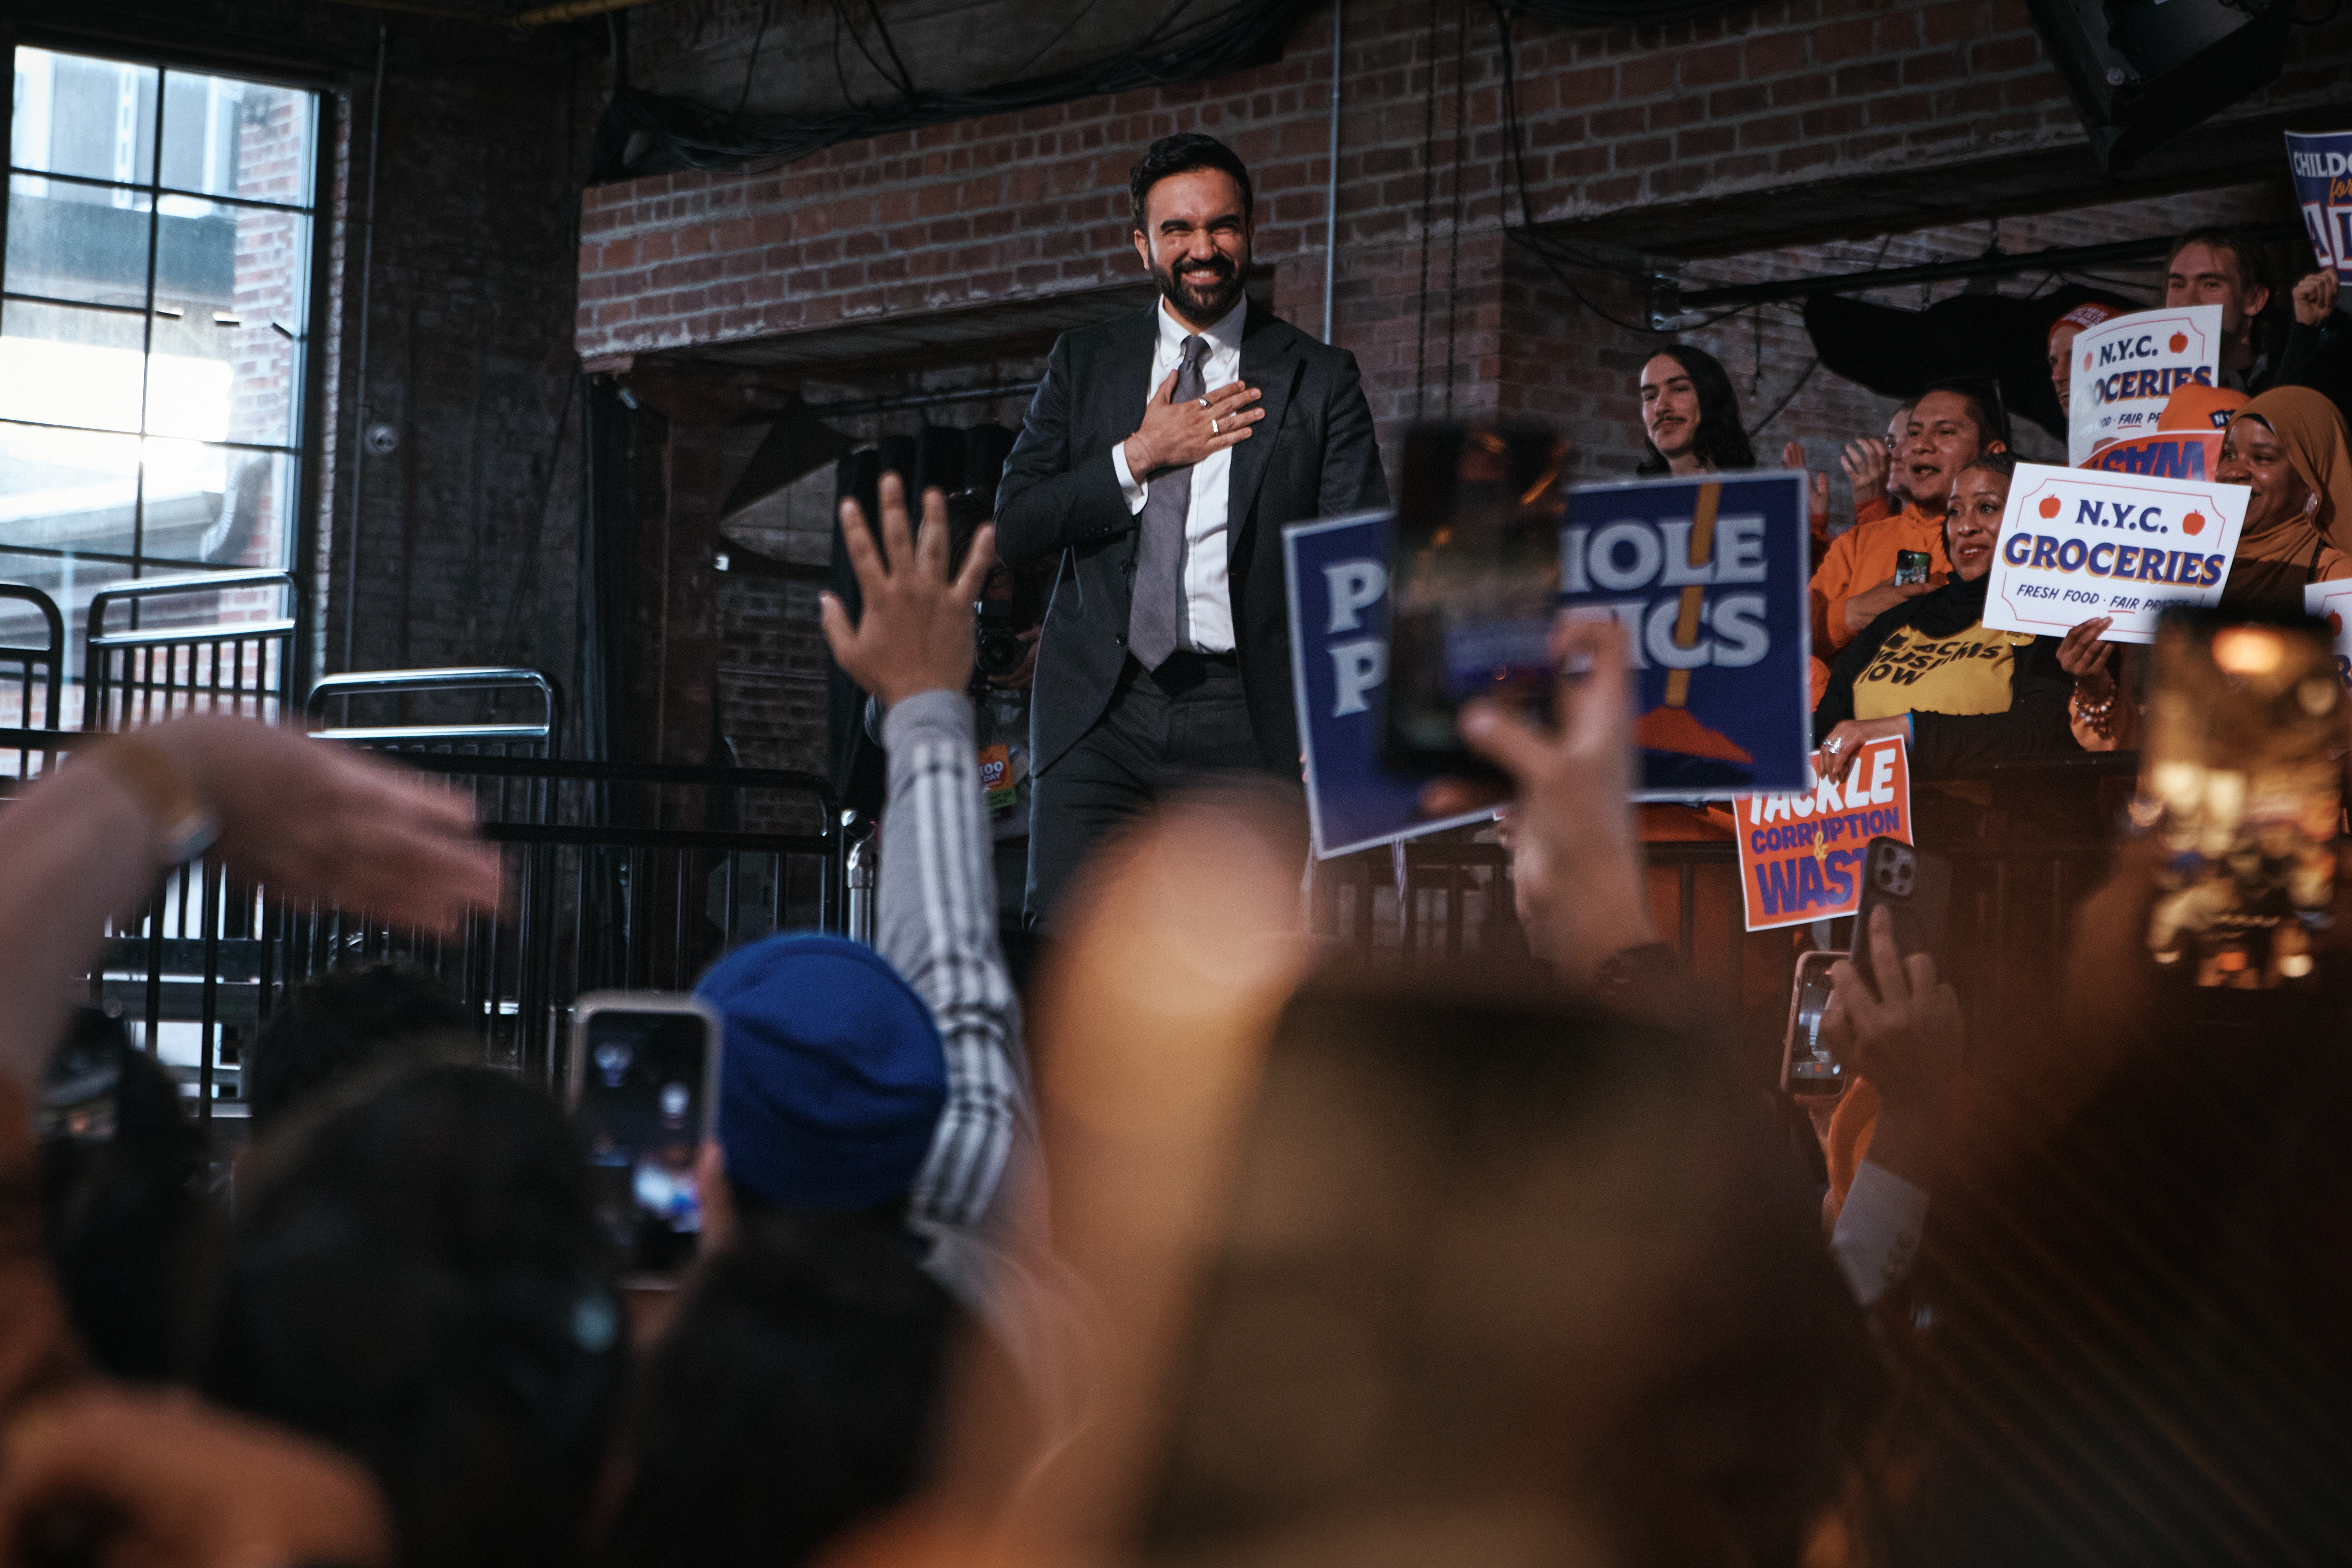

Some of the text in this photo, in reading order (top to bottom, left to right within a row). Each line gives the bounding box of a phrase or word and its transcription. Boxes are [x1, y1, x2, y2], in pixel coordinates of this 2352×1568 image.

[2293, 151, 2352, 178] CHILD
[2099, 335, 2158, 368] N.Y.C.
[2087, 365, 2212, 409] OCERIES
[2118, 412, 2143, 425] FAIR
[2092, 441, 2206, 482] WAS
[2075, 499, 2169, 535] N.Y.C.
[2002, 533, 2226, 589] GROCERIES
[2016, 584, 2060, 599] FRESH
[2063, 589, 2100, 605] FOOD
[2109, 596, 2140, 610] FAIR
[1751, 806, 1900, 855] CORRUPTION
[1813, 831, 1828, 861] &
